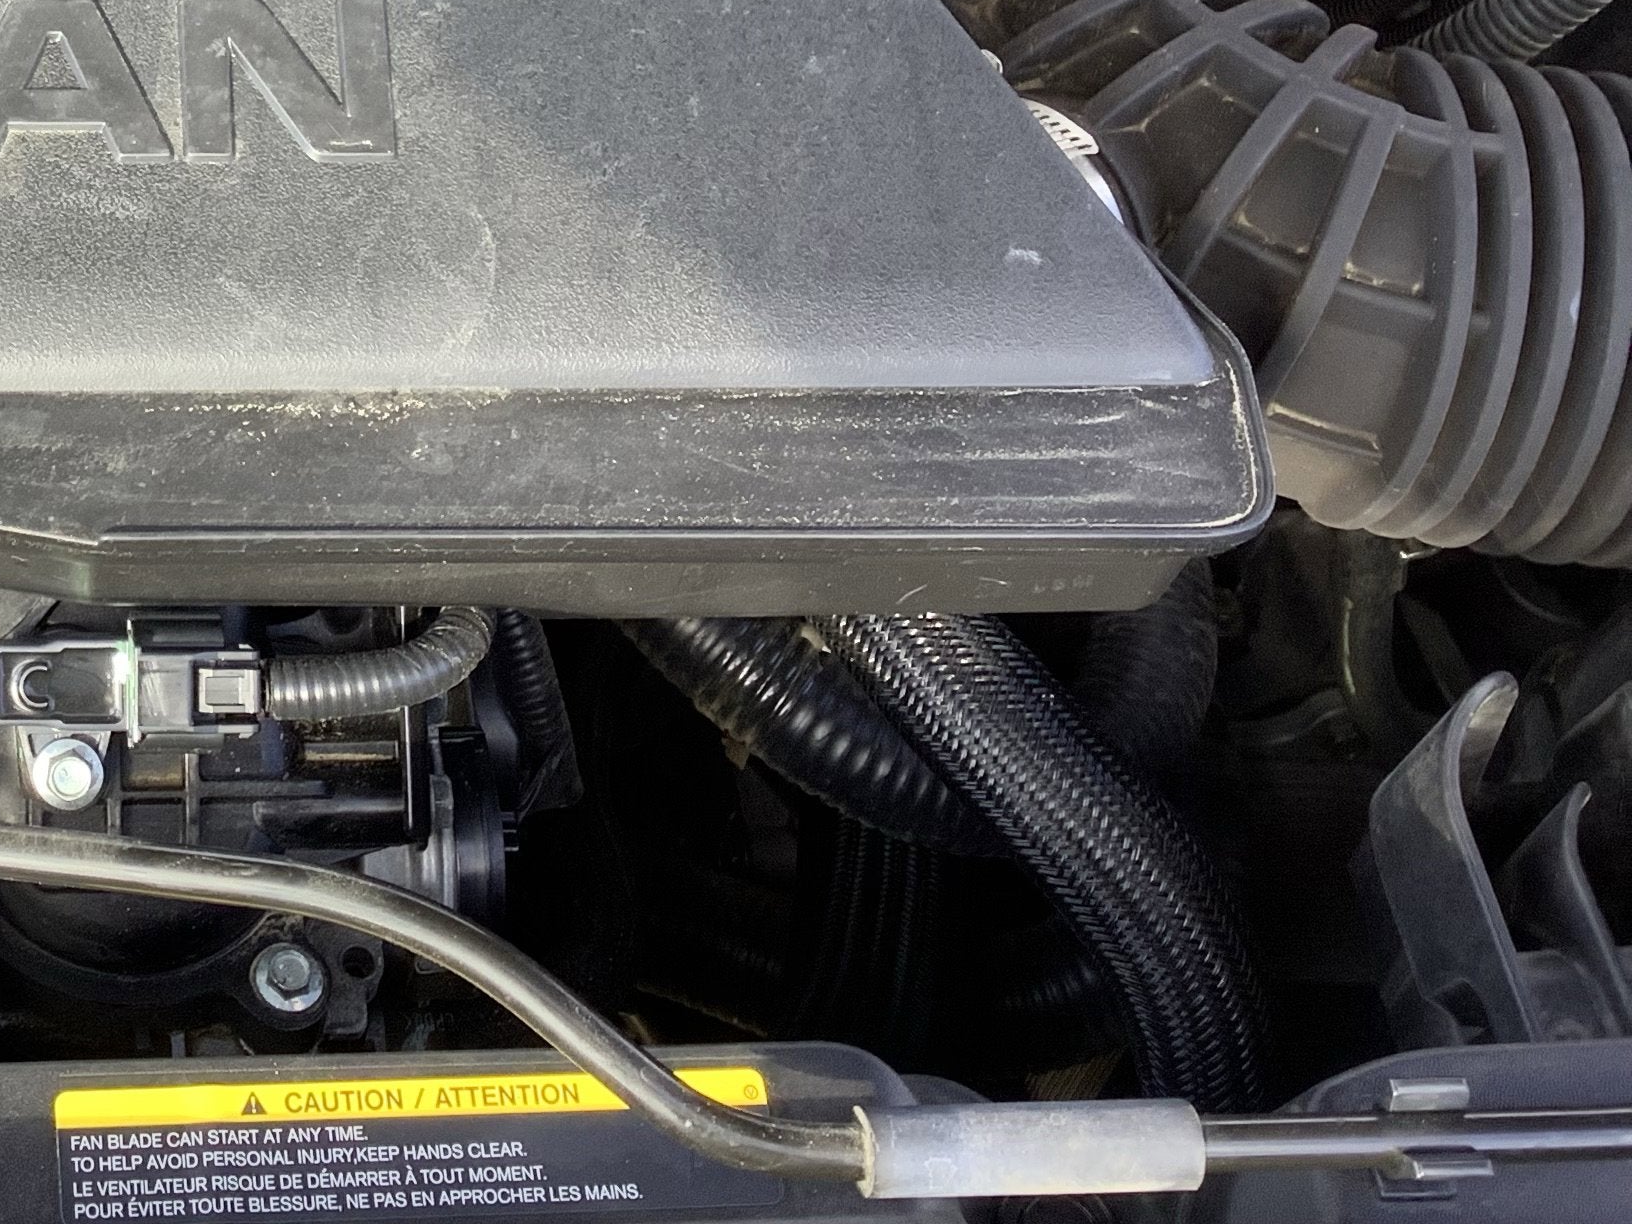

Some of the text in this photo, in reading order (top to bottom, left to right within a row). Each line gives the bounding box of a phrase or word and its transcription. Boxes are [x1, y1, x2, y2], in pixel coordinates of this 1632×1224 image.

[284, 1083, 580, 1114] CAUTION / ATTENTION
[70, 1125, 369, 1151] FAN BLADE CAN START AT ANY TIME.
[71, 1156, 95, 1173] TO
[99, 1154, 143, 1173] HELP
[146, 1152, 199, 1170] AVOID
[203, 1149, 294, 1168] PERSONAL
[404, 1143, 463, 1161] HANDS
[468, 1141, 527, 1158] CLEAR.
[73, 1164, 547, 1198] LE VENTILATEUR RISQUE DE DÉMARRER À TOUT MOMENT.
[74, 1183, 643, 1219] POUR ÉVITER TOUTE BLESSURE, NE PAS EN APPROCHER LES MAINS.
